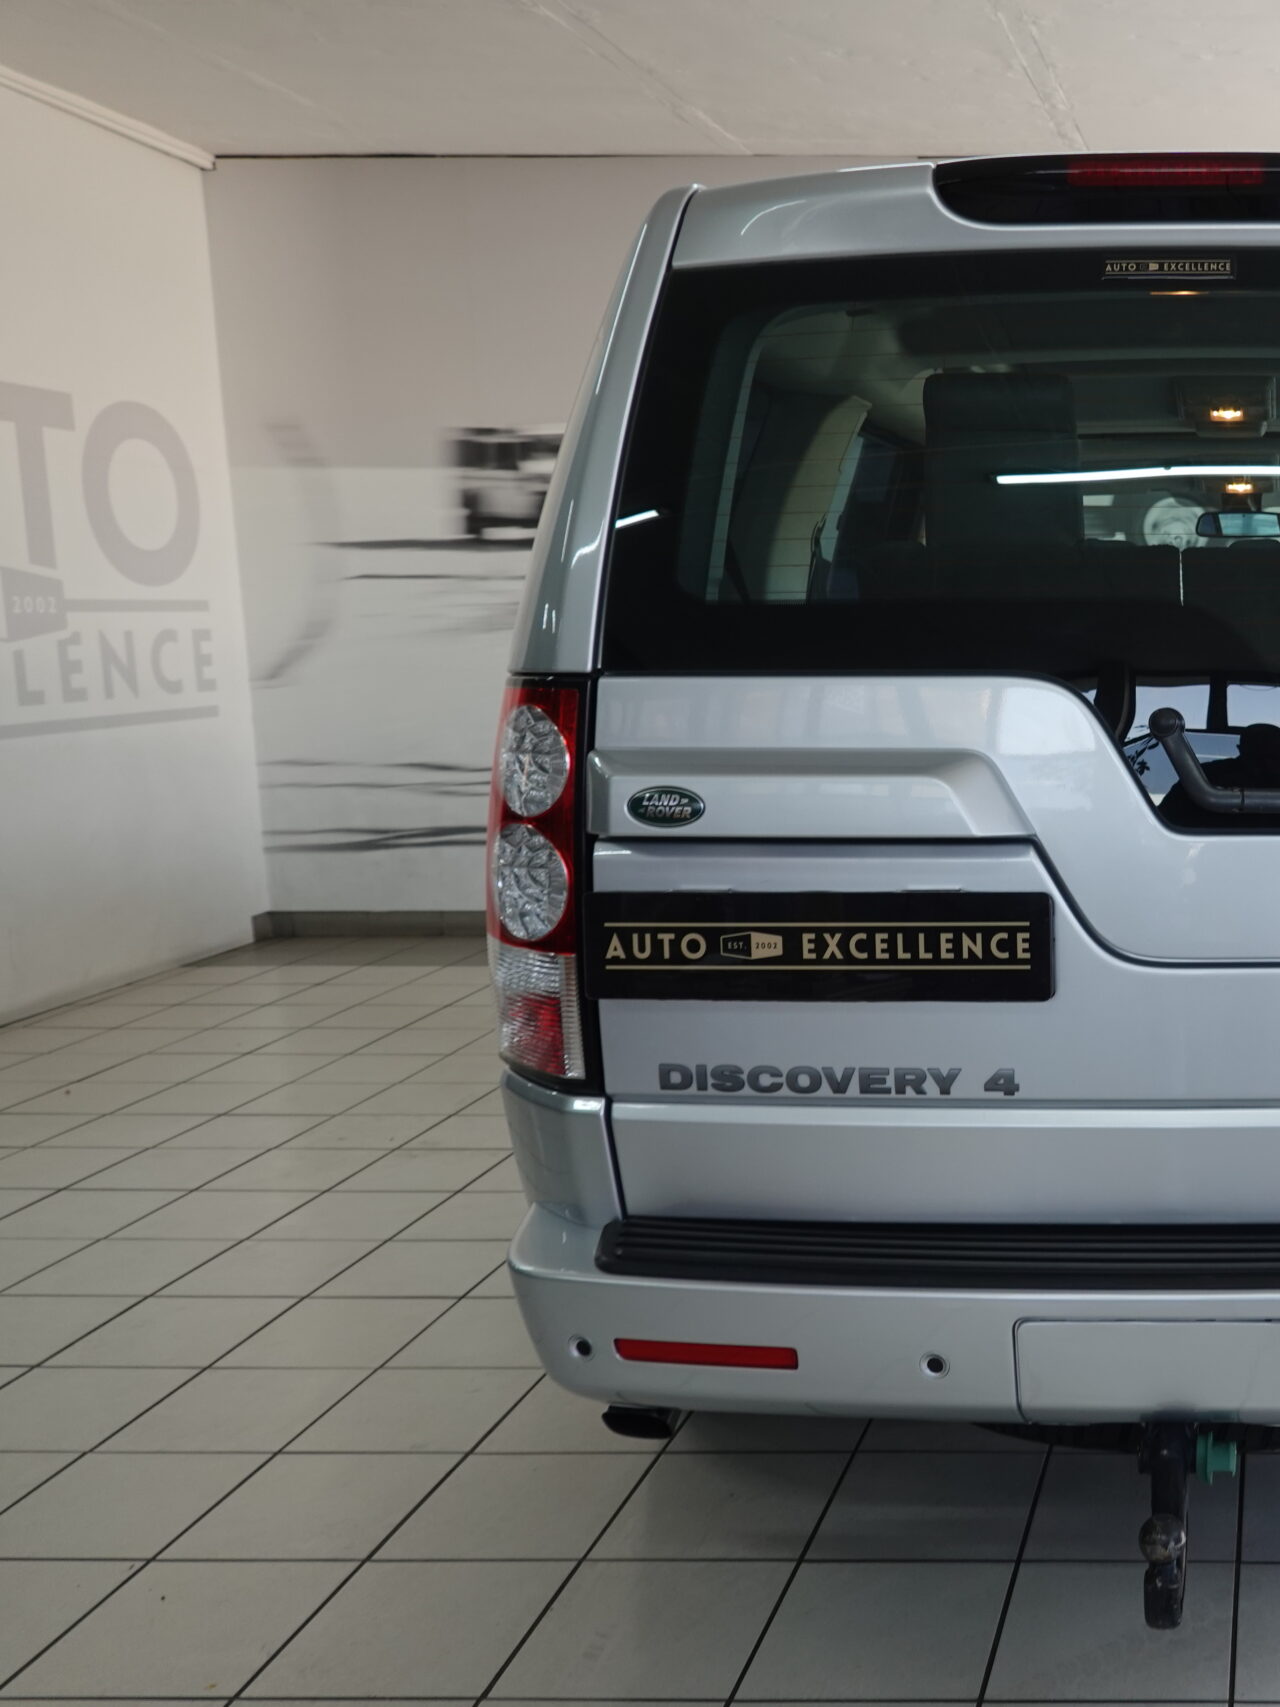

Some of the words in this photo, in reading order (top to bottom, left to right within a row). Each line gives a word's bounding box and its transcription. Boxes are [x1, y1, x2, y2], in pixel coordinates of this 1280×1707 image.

[1105, 262, 1137, 272] AUTO
[1163, 262, 1231, 272] EXCELLENCE
[642, 793, 680, 806] LAND
[646, 806, 692, 818] ROVER
[605, 932, 707, 960] AUTO
[755, 942, 778, 950] 2002
[802, 932, 1031, 960] EXCELLENCE
[658, 1062, 963, 1096] DISCOVERY
[983, 1067, 1020, 1097] 4
